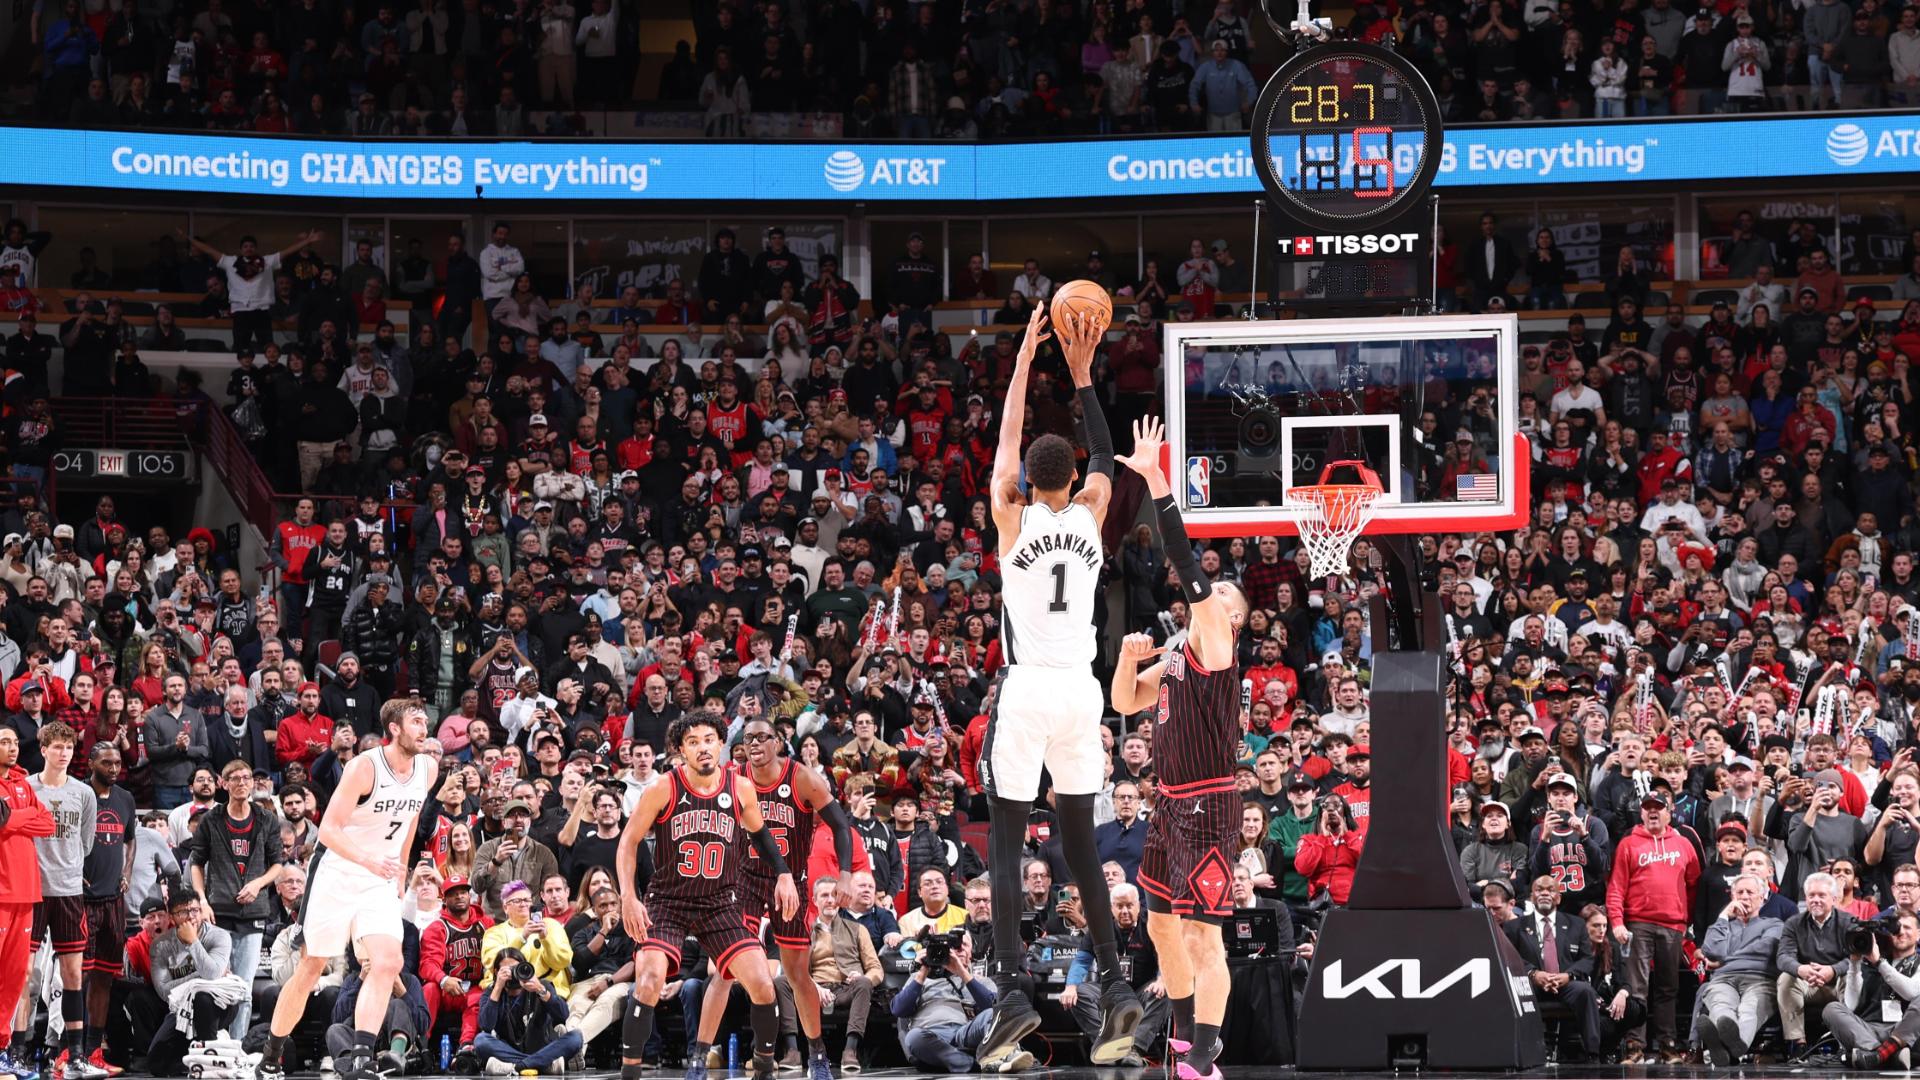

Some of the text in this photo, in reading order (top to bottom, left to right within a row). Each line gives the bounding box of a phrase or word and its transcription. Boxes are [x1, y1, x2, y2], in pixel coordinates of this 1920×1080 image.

[1291, 83, 1375, 123] 28.7
[112, 146, 289, 187] Connecting
[301, 153, 463, 185] CHANGES
[870, 158, 946, 185] AT&T
[1295, 142, 1458, 180] CHANGS
[1353, 127, 1394, 198] 5
[1316, 233, 1419, 255] TISSOT
[53, 453, 175, 473] 04 EXIT 105
[1011, 533, 1099, 571] WEMBANYAMA
[326, 575, 344, 591] 24
[1047, 561, 1069, 614] 1
[64, 810, 80, 824] FOR
[671, 809, 736, 843] CHICAGO
[757, 802, 795, 828] CAGO
[384, 821, 402, 841] 7
[749, 828, 790, 859] 5
[677, 840, 725, 880] 30
[1638, 849, 1681, 867] Chicago
[1551, 864, 1586, 893] 23
[446, 938, 482, 960] BULL
[450, 959, 482, 980] 23
[1322, 957, 1491, 999] KIA
